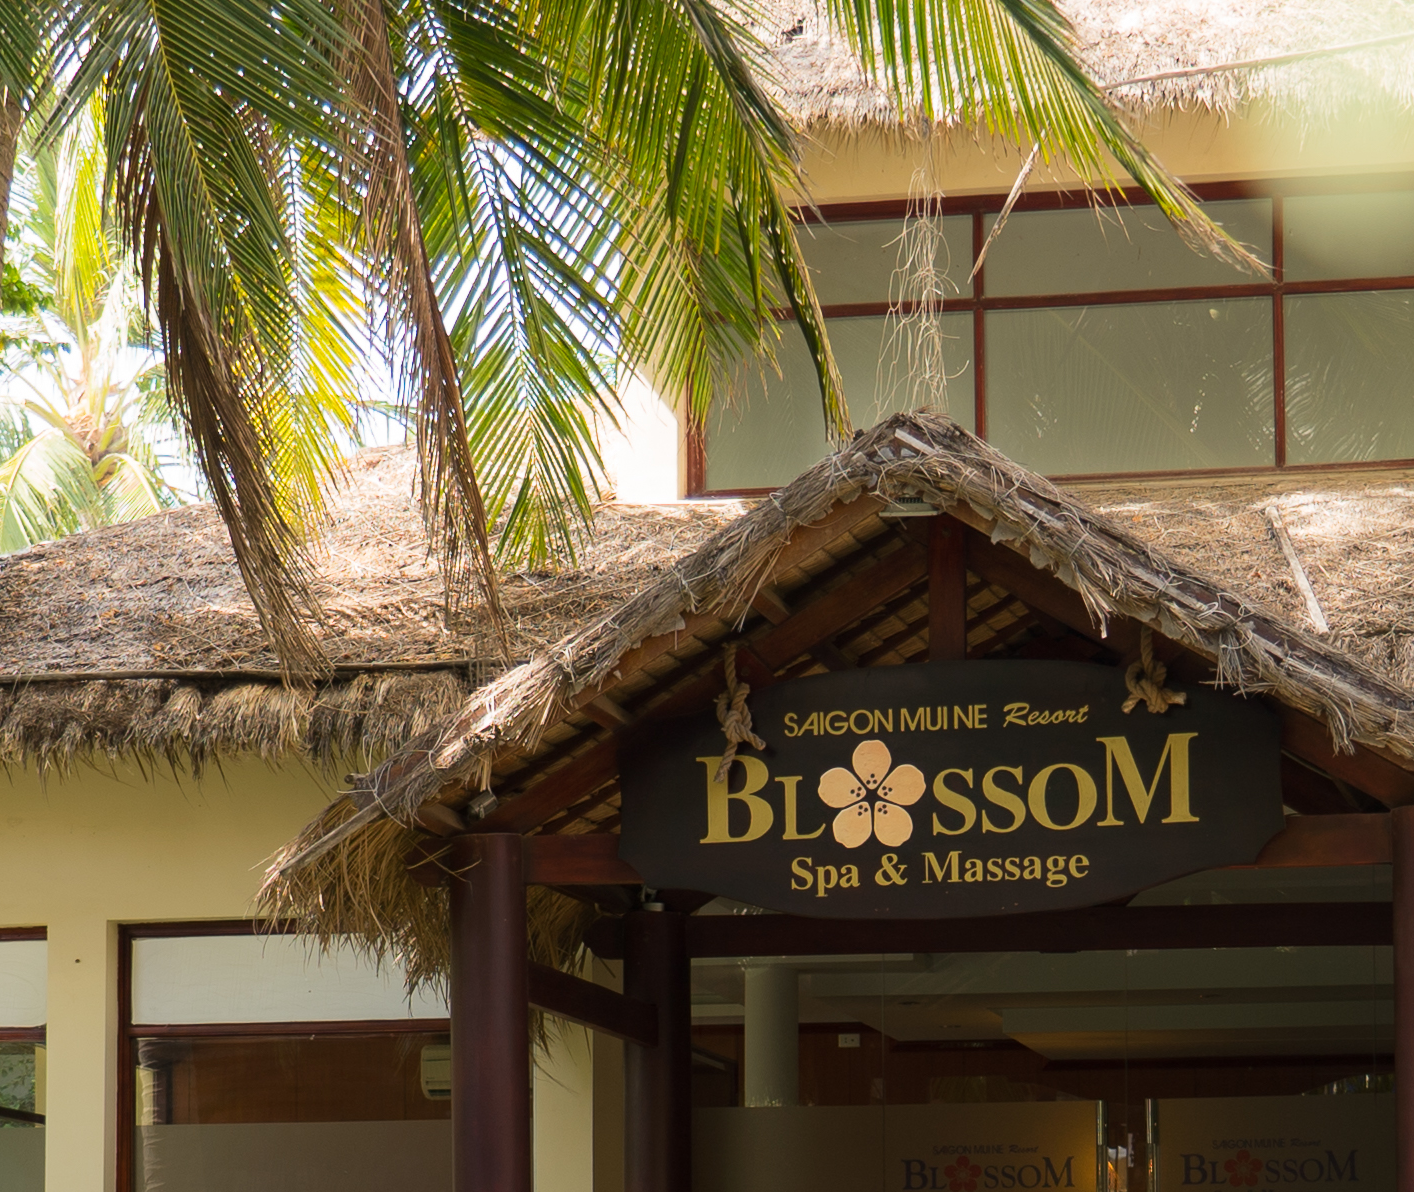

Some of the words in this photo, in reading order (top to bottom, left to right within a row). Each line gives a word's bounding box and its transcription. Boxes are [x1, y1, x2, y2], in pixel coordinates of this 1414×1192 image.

[784, 708, 893, 737] SAIGON
[1003, 702, 1090, 728] Resort
[790, 856, 861, 897] Spa
[874, 852, 908, 886] &
[921, 847, 1090, 888] Massage
